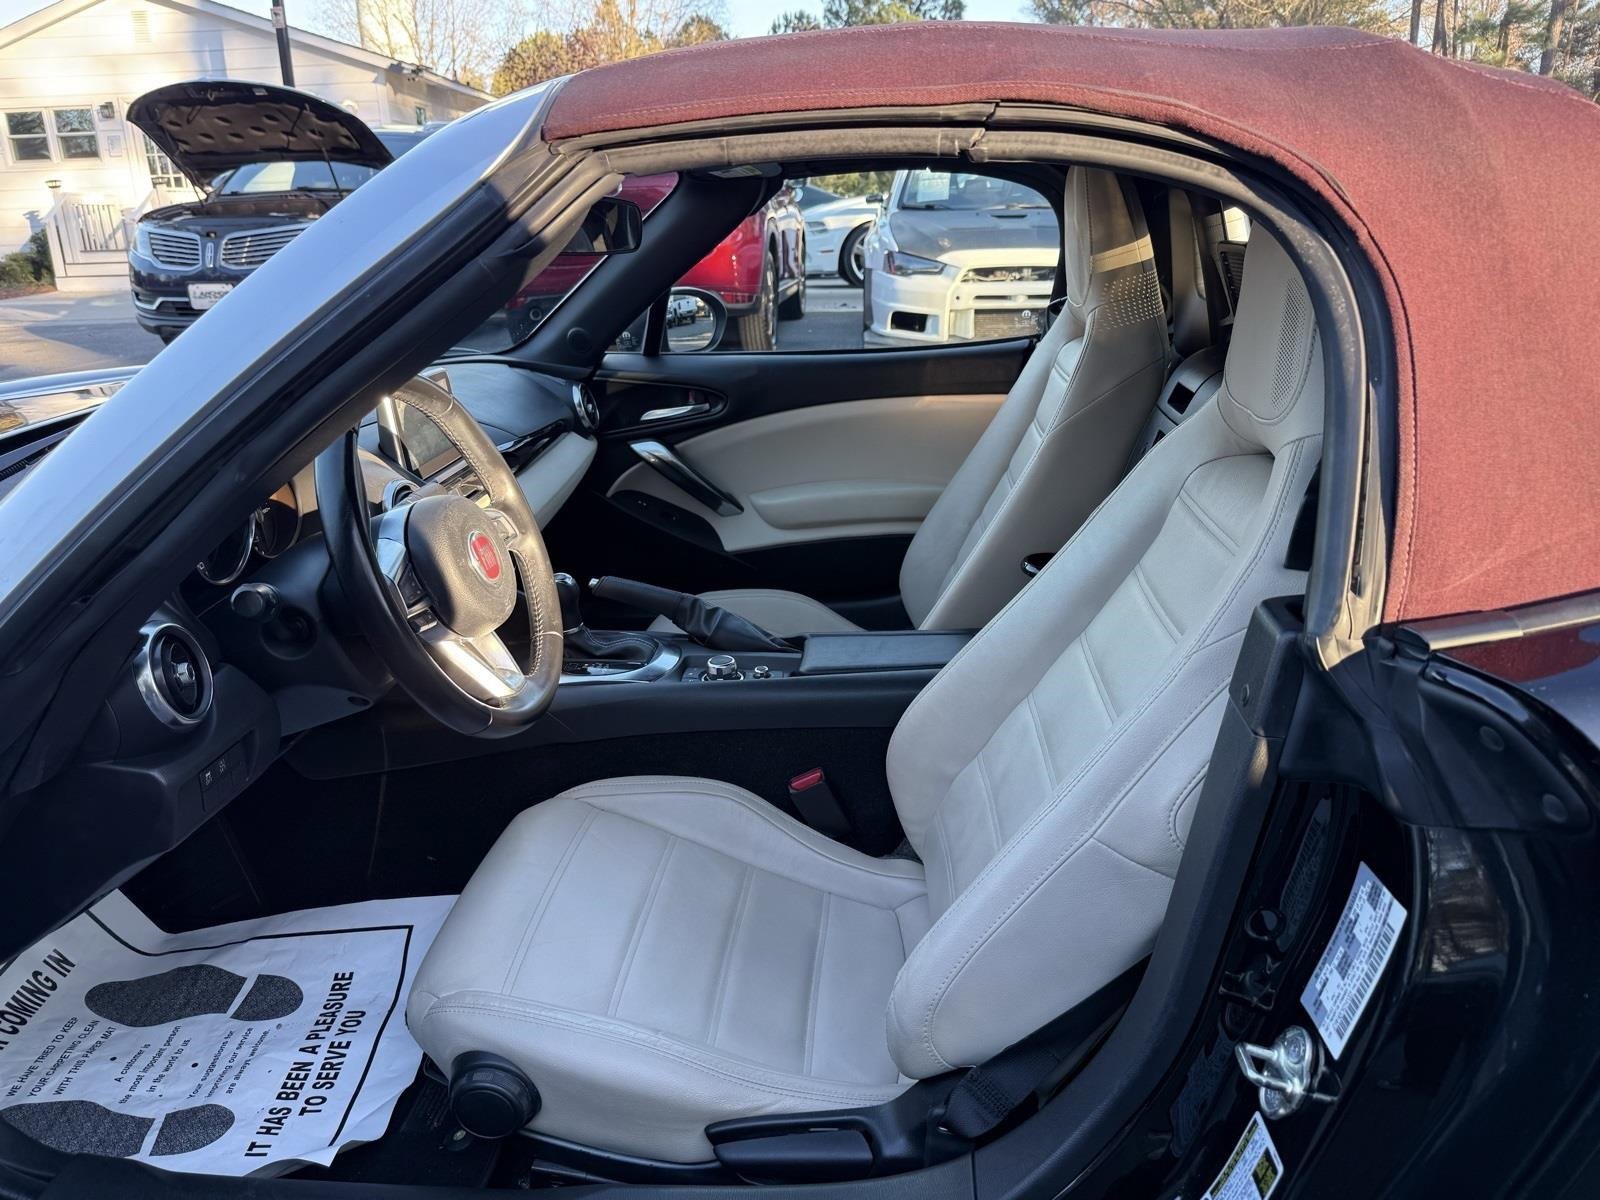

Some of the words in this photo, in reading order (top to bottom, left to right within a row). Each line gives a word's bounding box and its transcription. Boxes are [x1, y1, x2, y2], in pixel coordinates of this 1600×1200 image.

[0, 970, 58, 1034] COMING
[43, 948, 76, 978] IN
[305, 972, 354, 1040] PLEASURE
[334, 1010, 366, 1036] YOU
[6, 1084, 22, 1097] WE
[18, 1064, 39, 1084] HAVE
[34, 1044, 56, 1064] TRIED
[52, 1034, 64, 1047] TO
[60, 1017, 78, 1036] KEEP
[27, 1075, 50, 1098] YOUR
[46, 1040, 82, 1076] CARPETING
[78, 1020, 100, 1040] CLEAN
[52, 1076, 74, 1096] WITH
[68, 1058, 86, 1076] THIS
[82, 1040, 104, 1059] PAPER
[100, 1026, 116, 1040] MAT
[118, 1094, 132, 1104] the
[129, 1074, 144, 1092] most
[139, 1048, 168, 1073] important
[164, 1026, 182, 1047] person
[121, 1050, 145, 1074] customer
[152, 1074, 166, 1083] the
[162, 1056, 178, 1072] world
[186, 1084, 203, 1099] Your
[200, 1040, 228, 1082] suggestions
[204, 1065, 232, 1098] improving
[228, 1052, 239, 1064] our
[236, 1028, 254, 1050] service
[298, 1044, 321, 1055] A
[312, 1040, 352, 1090] SERVE
[226, 1082, 236, 1094] are
[234, 1058, 252, 1080] always
[276, 1061, 314, 1100] BEEN
[256, 1106, 292, 1136] HAS
[298, 1095, 328, 1116] TO
[244, 1141, 272, 1157] IT
